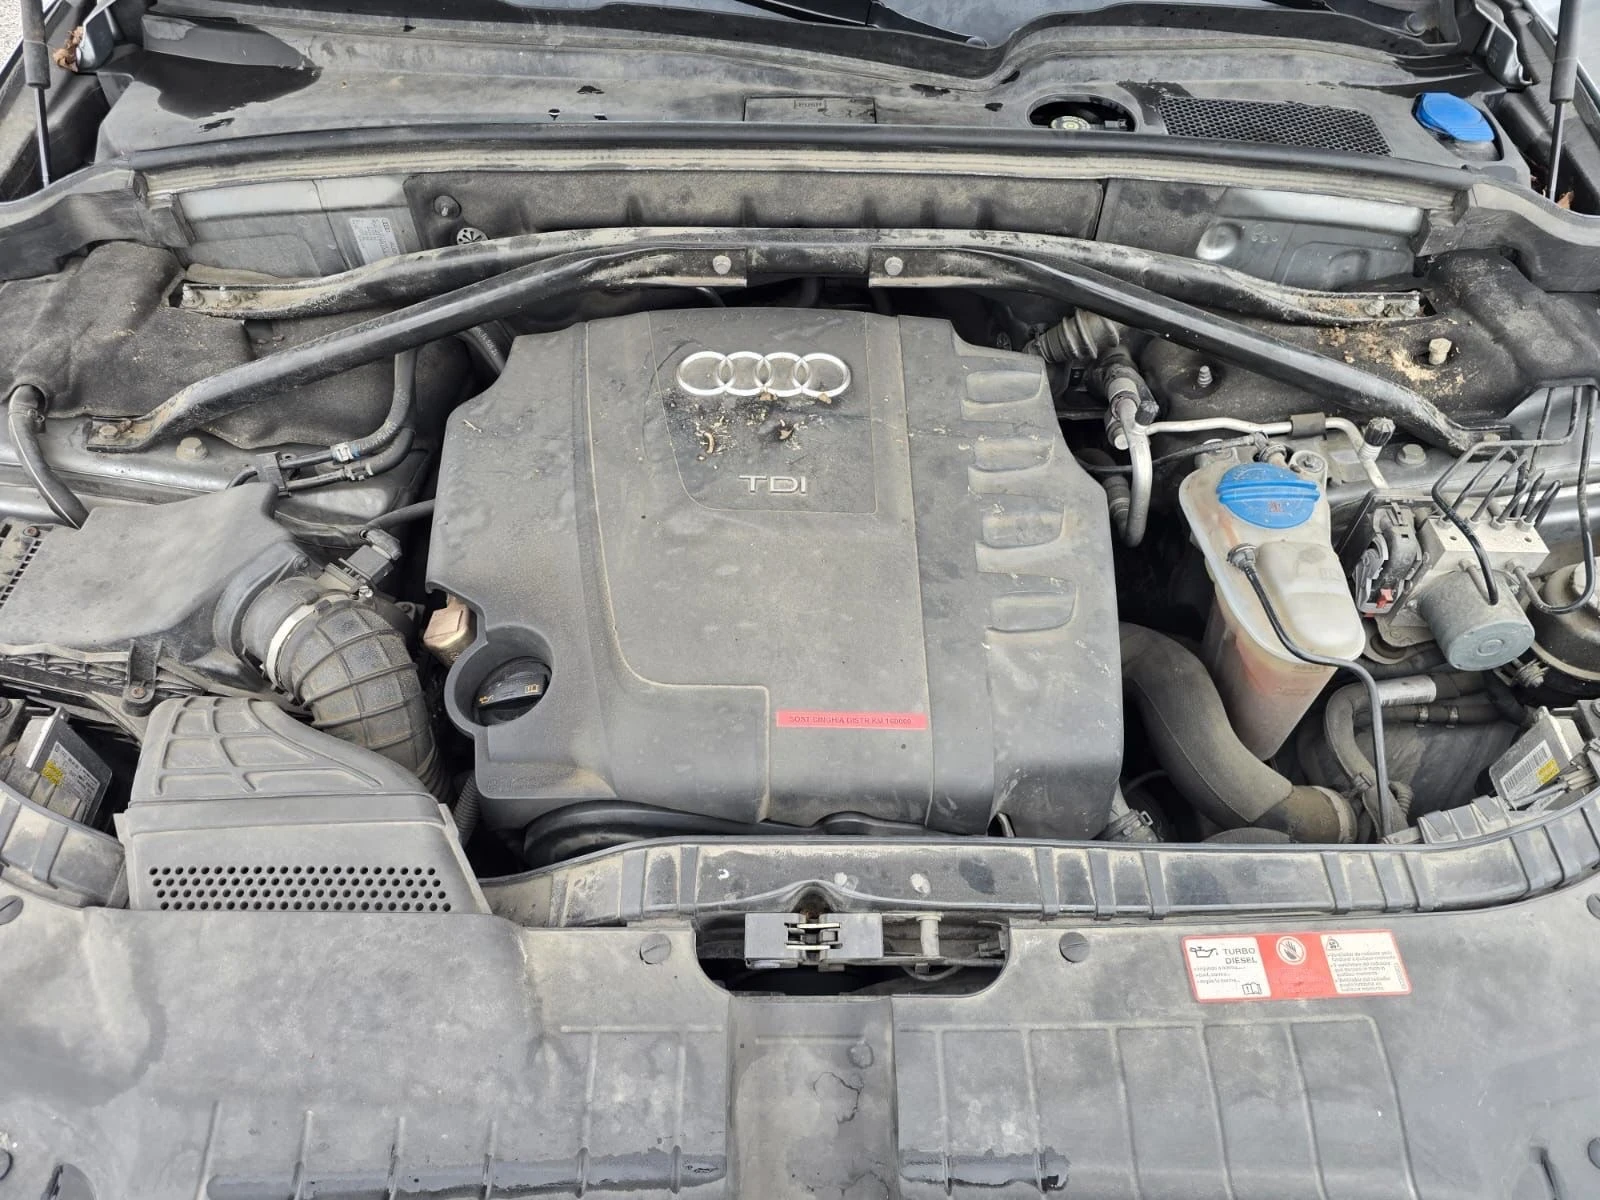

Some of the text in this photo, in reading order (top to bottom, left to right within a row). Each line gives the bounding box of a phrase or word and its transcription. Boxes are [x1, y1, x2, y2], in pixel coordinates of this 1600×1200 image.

[739, 475, 806, 494] TDI
[1223, 947, 1256, 955] TURBO
[1225, 957, 1258, 965] DIESEL
